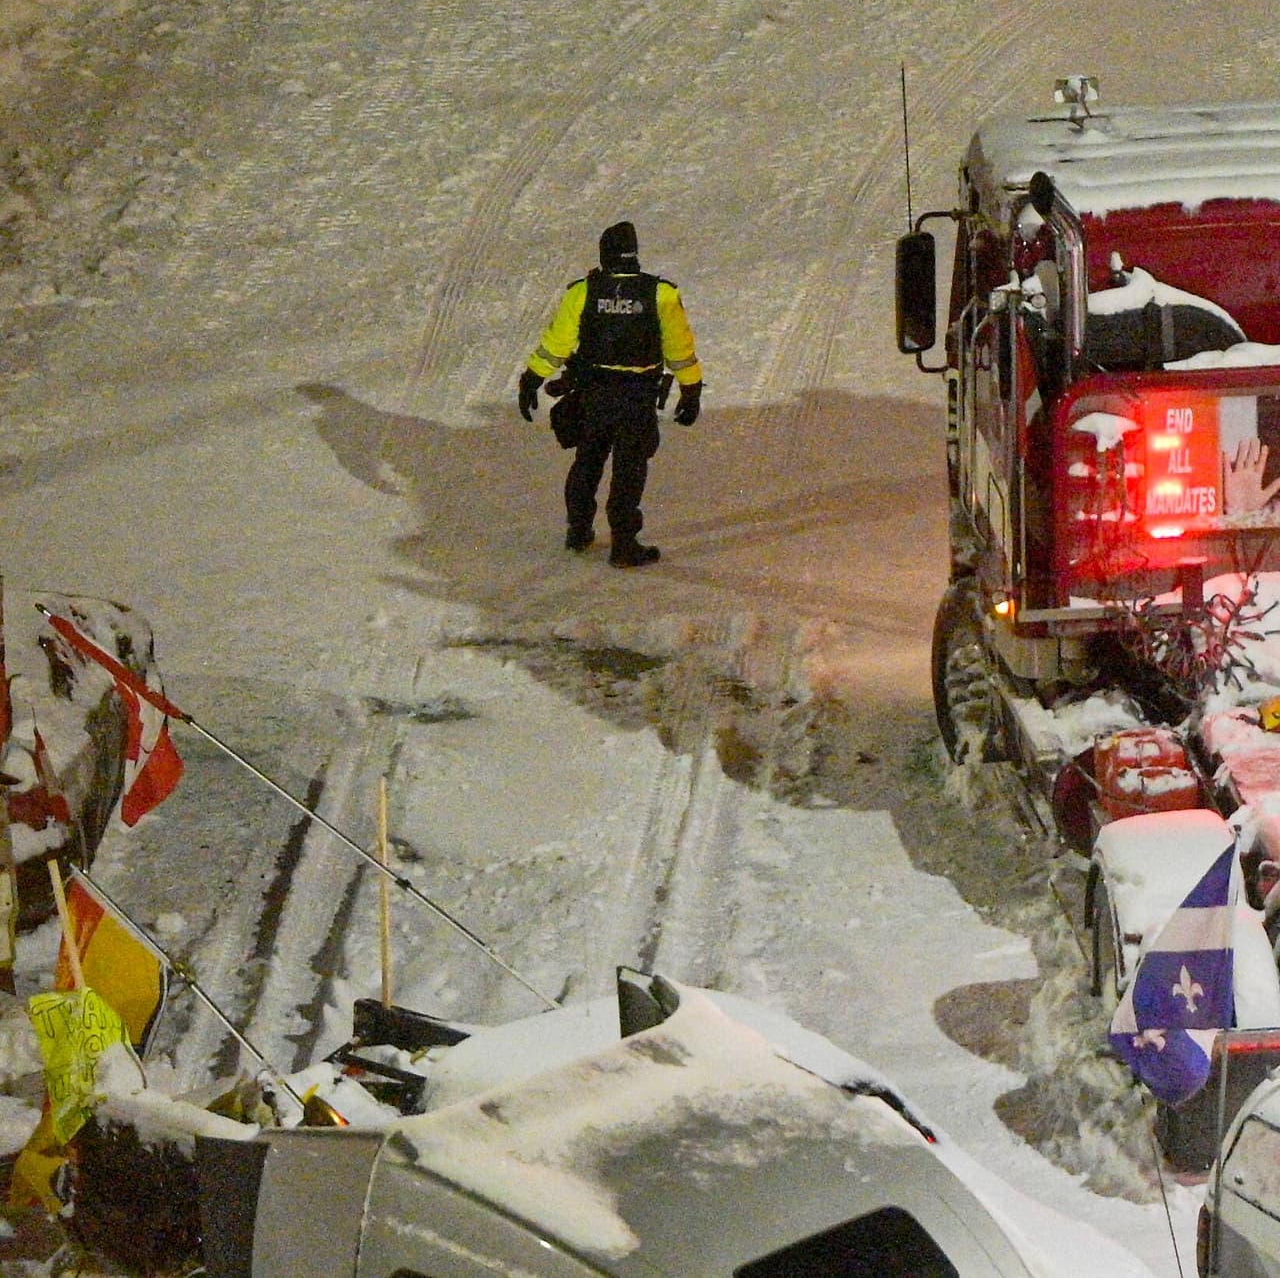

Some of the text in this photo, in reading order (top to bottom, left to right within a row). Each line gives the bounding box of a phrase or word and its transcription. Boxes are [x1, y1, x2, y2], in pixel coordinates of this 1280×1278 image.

[597, 298, 633, 314] POLICE
[1167, 407, 1193, 433] END
[1168, 449, 1192, 473] ALL
[1146, 486, 1216, 515] MANDATES
